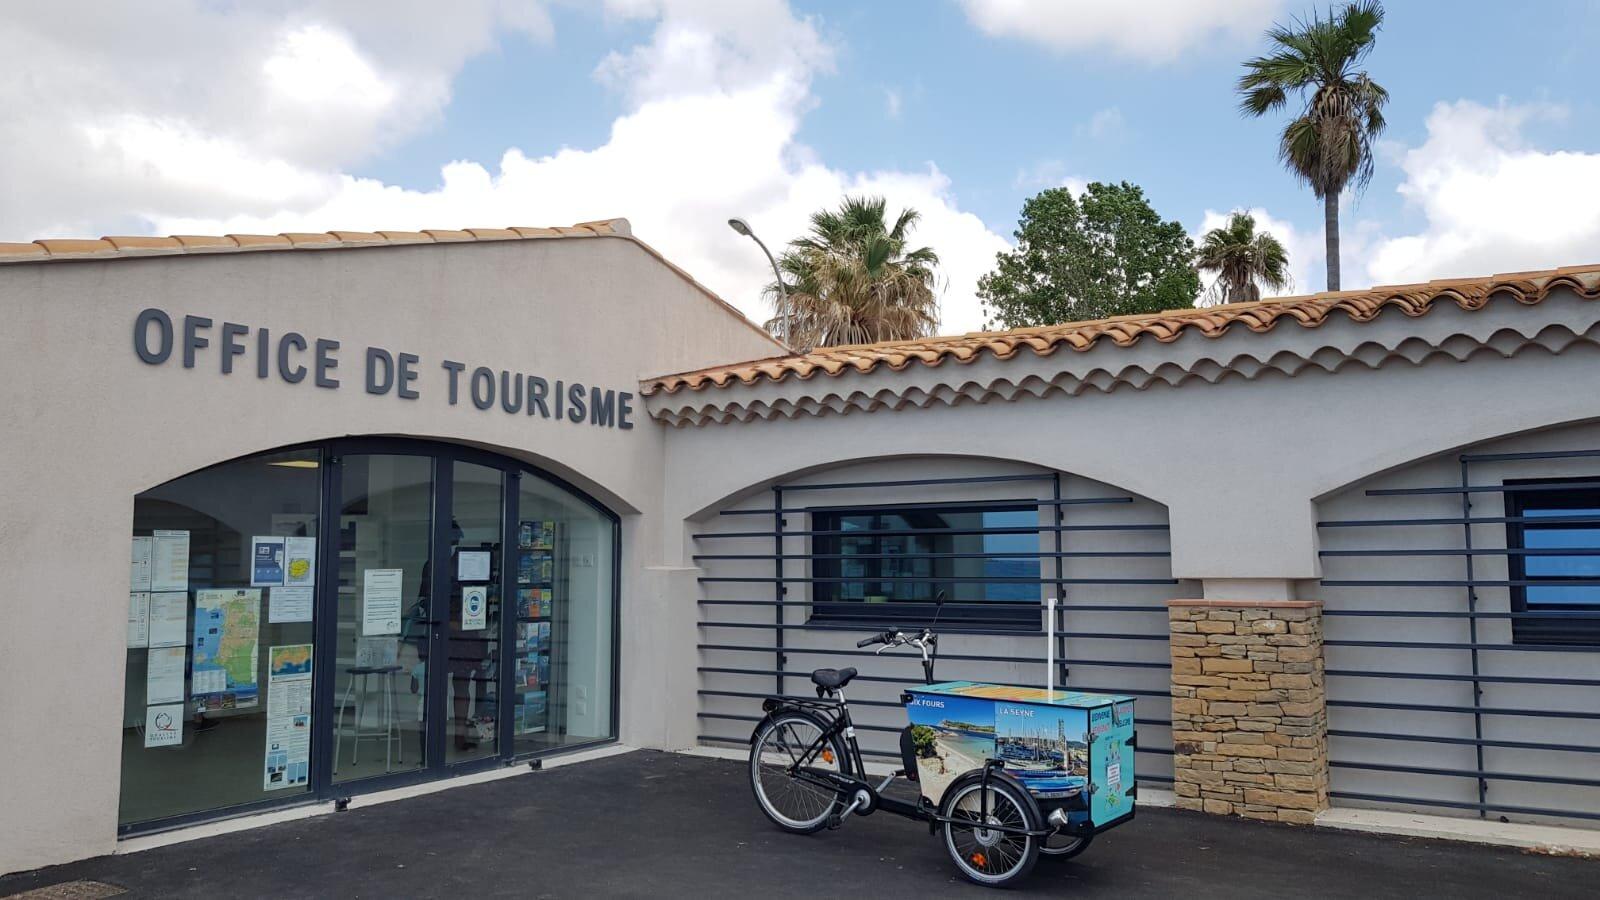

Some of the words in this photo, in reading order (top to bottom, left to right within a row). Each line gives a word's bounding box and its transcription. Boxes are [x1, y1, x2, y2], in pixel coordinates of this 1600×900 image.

[134, 308, 340, 389] OFFICE
[365, 346, 420, 400] DE
[443, 361, 634, 429] TOURISME
[922, 699, 945, 708] FOURS
[999, 707, 1009, 715] LA
[1010, 708, 1035, 717] SEYNE
